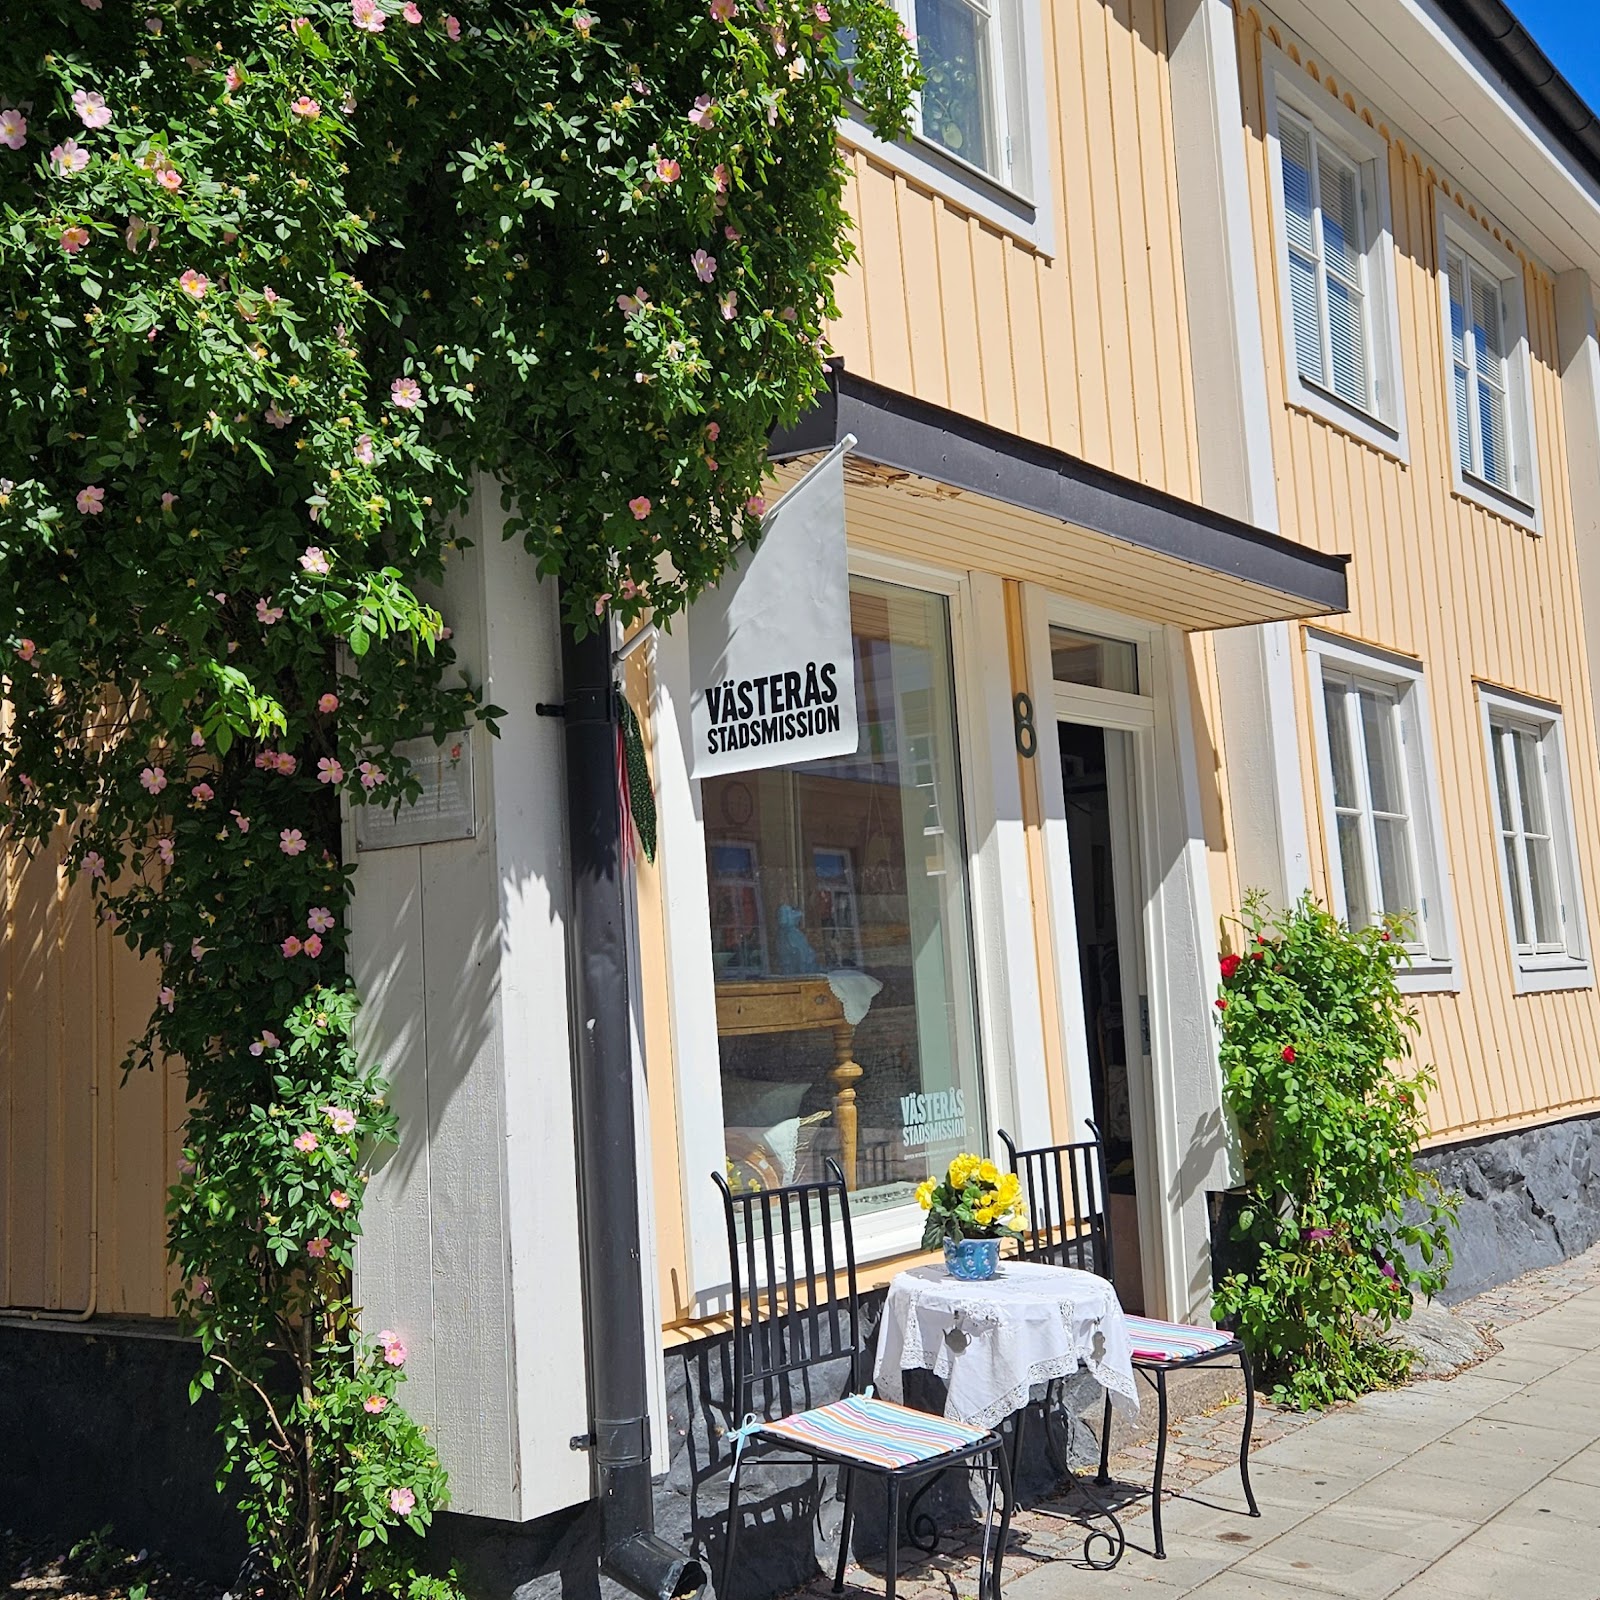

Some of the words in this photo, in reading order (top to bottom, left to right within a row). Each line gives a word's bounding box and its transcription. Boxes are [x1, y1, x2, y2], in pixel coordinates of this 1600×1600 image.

[705, 662, 837, 725] VÄSTERÅS
[707, 705, 840, 754] STADSMISSION
[1013, 692, 1037, 758] 8
[900, 1086, 966, 1125] VÄSTERÅS
[902, 1118, 967, 1147] STADSMISSION
